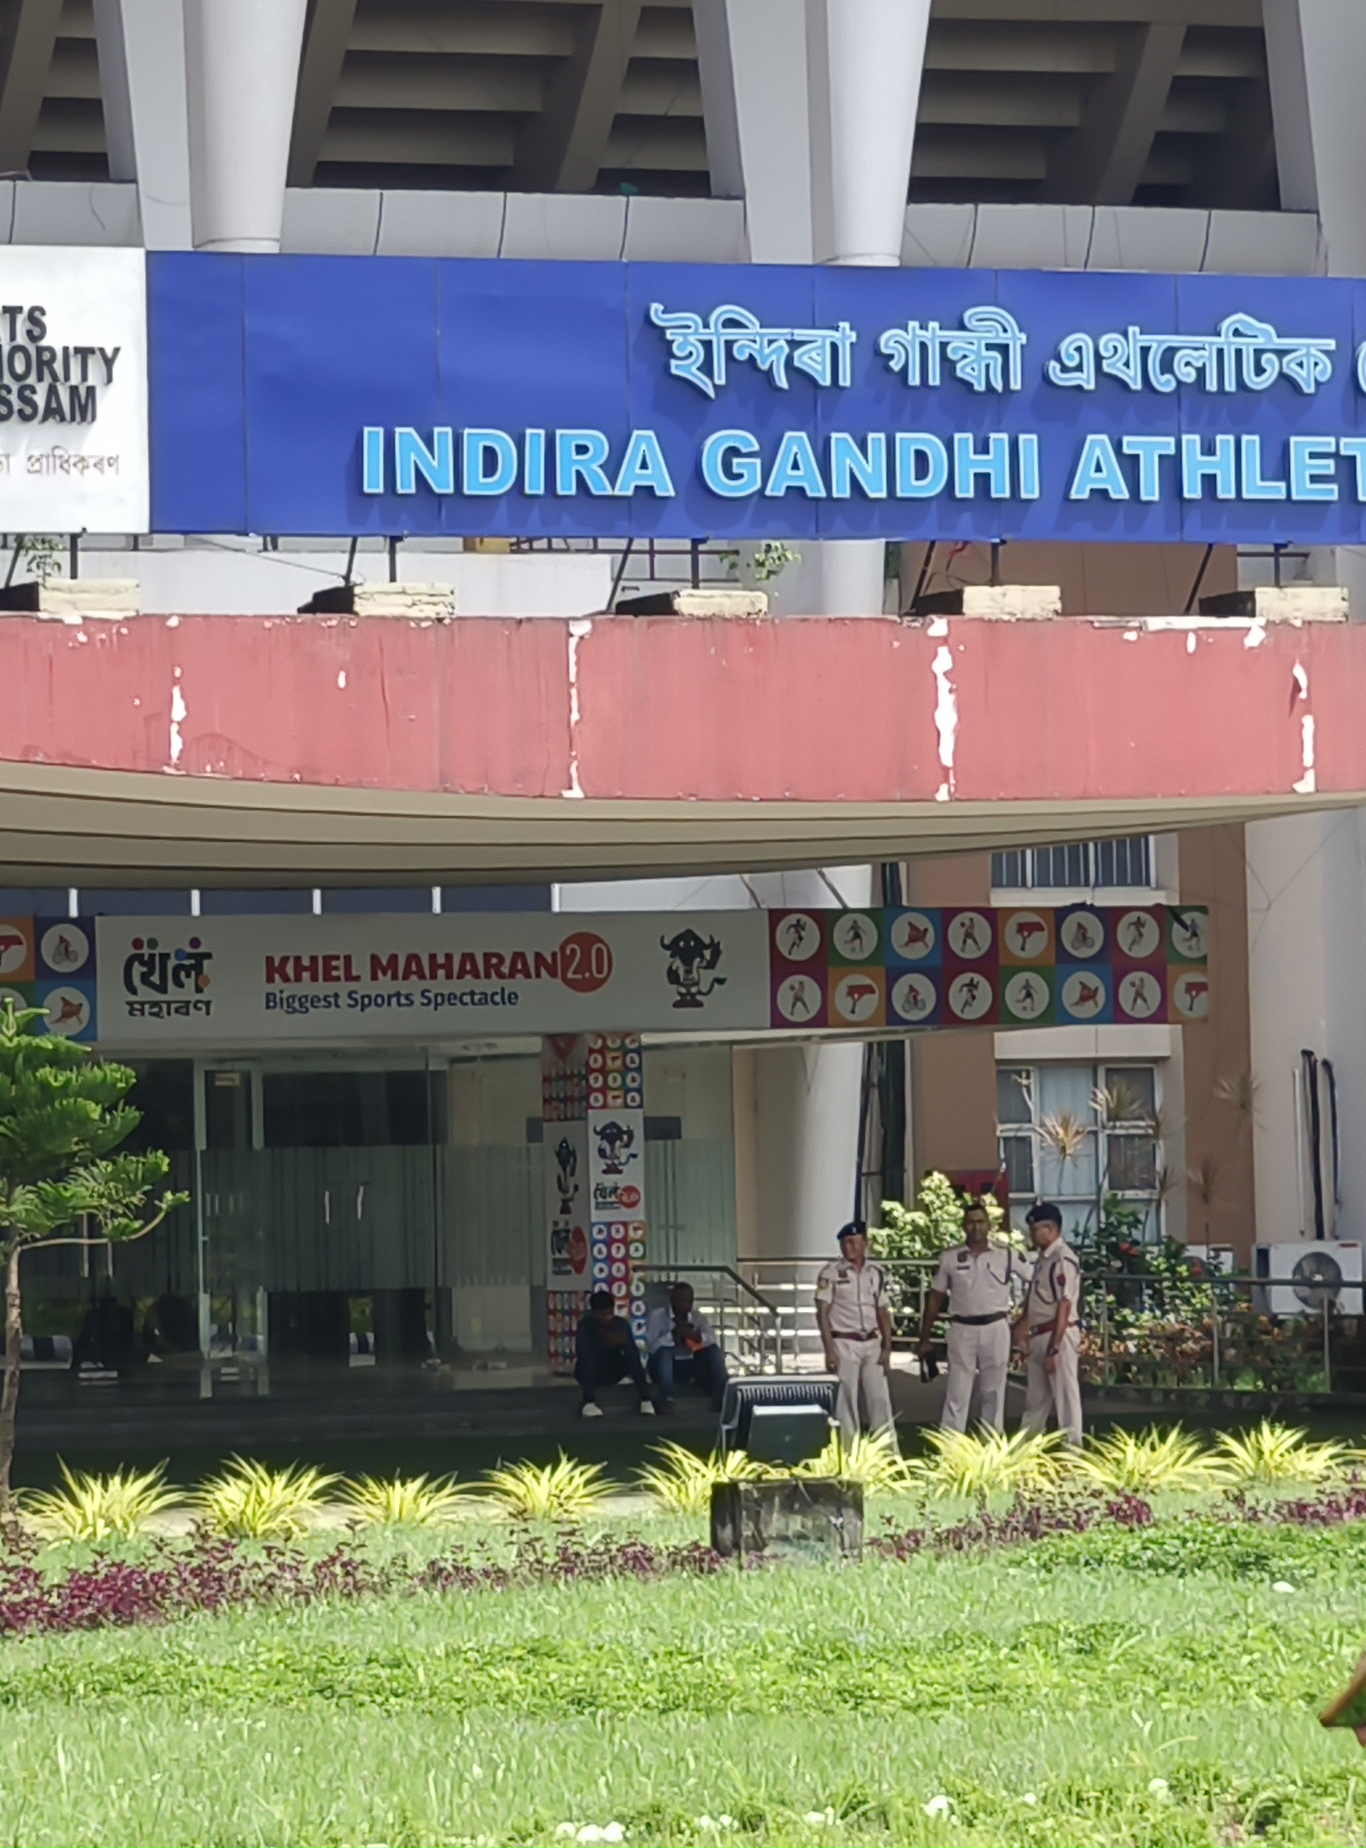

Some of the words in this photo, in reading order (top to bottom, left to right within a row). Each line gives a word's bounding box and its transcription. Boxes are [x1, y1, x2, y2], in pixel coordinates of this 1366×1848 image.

[649, 302, 857, 400] ইন্দিৰা
[879, 305, 1027, 393] গান্ধী
[1044, 312, 1336, 395] এথলেটিক
[362, 426, 676, 498] INDIRA
[700, 429, 1040, 499] GANDHI
[265, 953, 362, 984] KHEL
[369, 951, 560, 982] MAHARAN
[565, 942, 609, 980] 2.0
[265, 989, 342, 1015] Biggest
[346, 989, 415, 1013] Sports
[419, 985, 520, 1012] Spectacle
